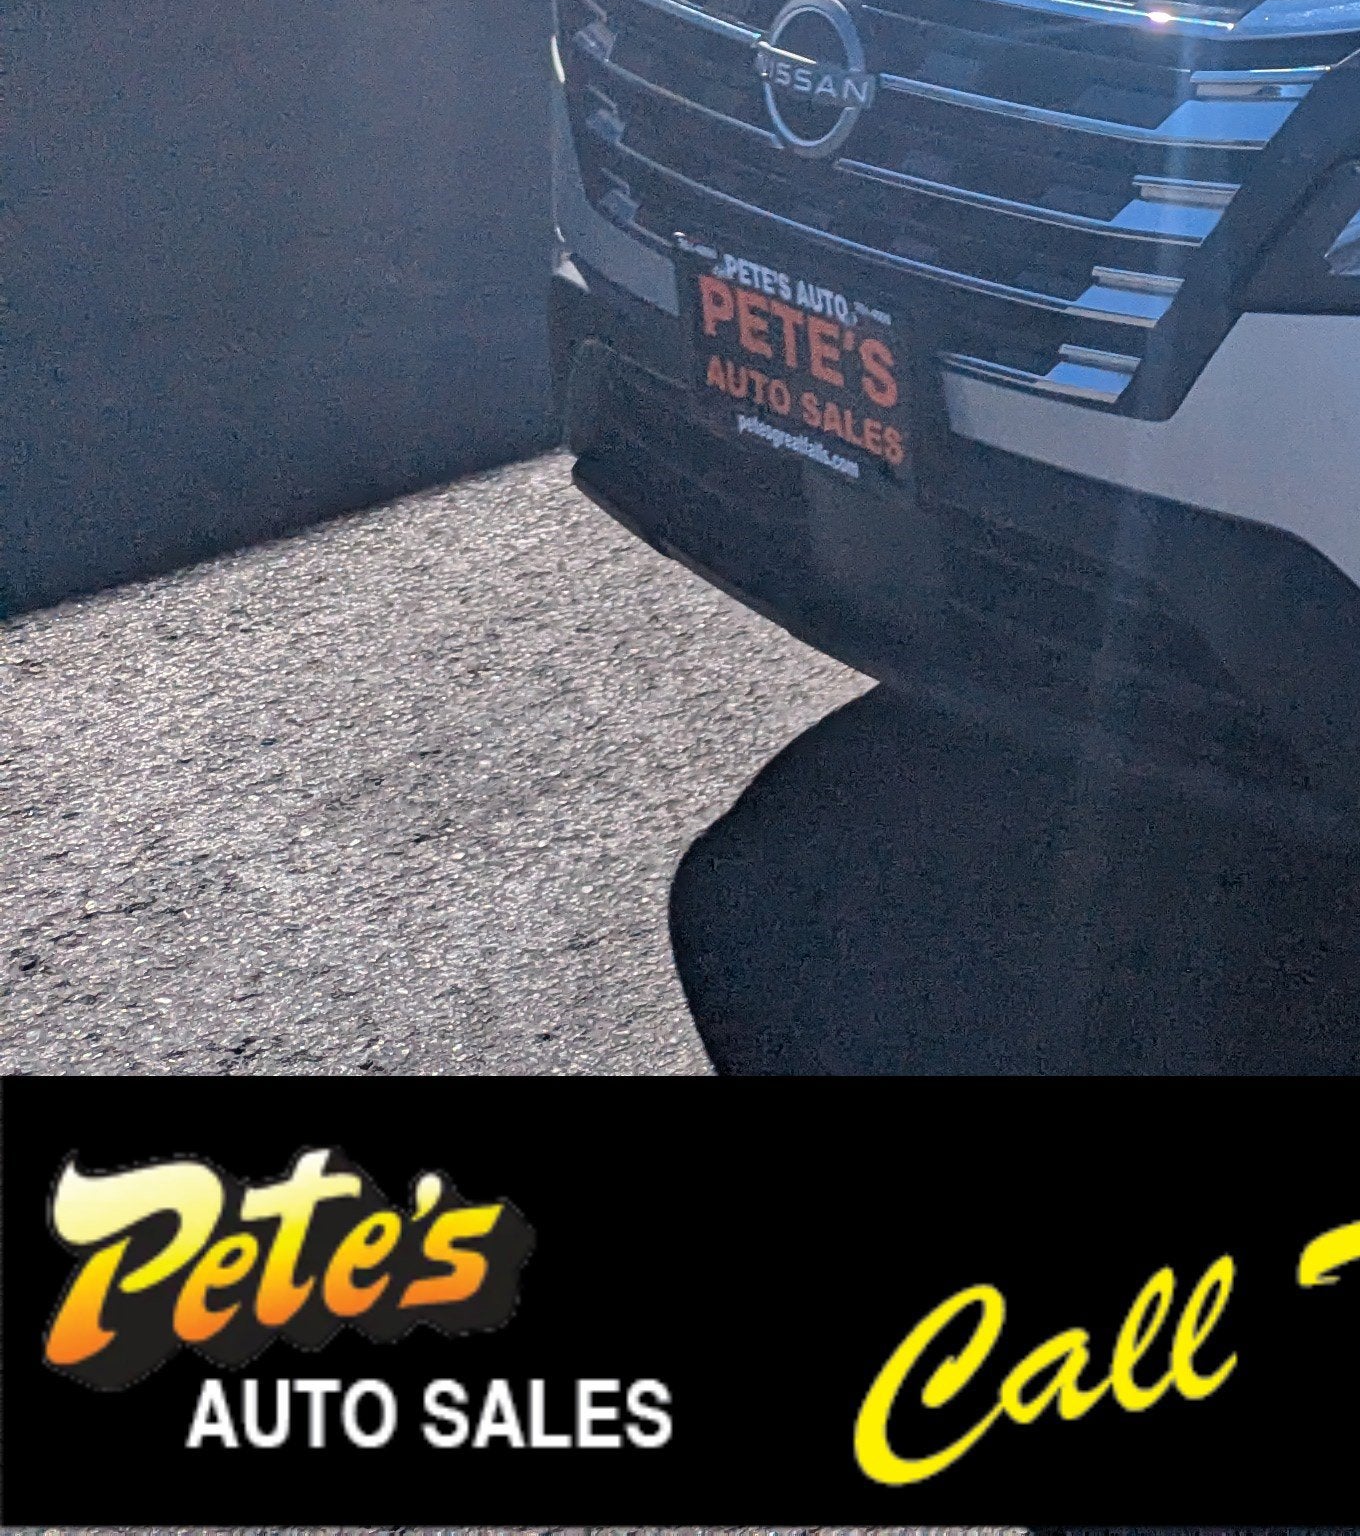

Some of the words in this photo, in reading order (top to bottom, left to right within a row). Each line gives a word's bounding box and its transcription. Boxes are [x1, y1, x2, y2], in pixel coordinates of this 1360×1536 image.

[756, 52, 869, 105] NISSAN
[722, 253, 793, 301] PETE'S
[699, 274, 898, 408] PETE'S
[706, 354, 792, 415] AUTO
[801, 390, 904, 465] SALES
